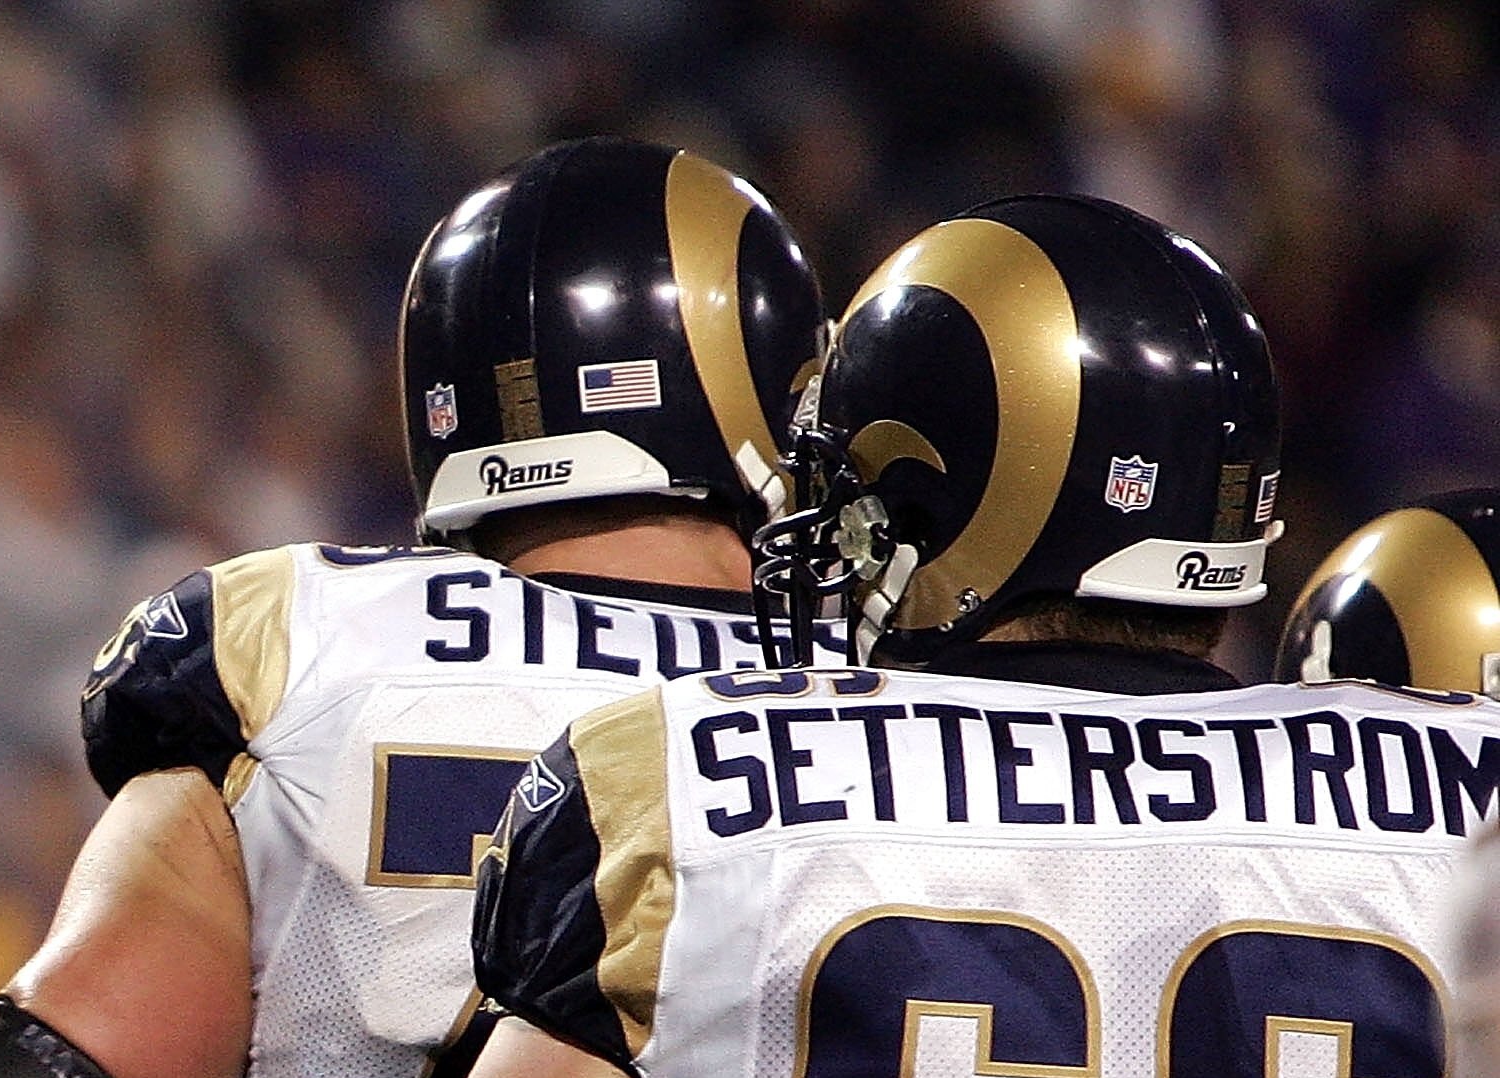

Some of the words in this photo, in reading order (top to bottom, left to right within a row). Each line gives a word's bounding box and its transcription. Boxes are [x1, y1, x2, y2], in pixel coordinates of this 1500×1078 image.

[480, 454, 573, 495] Rams
[1112, 479, 1149, 504] NFL
[1176, 550, 1247, 591] Rams
[691, 702, 1500, 838] SETTERSTROM
